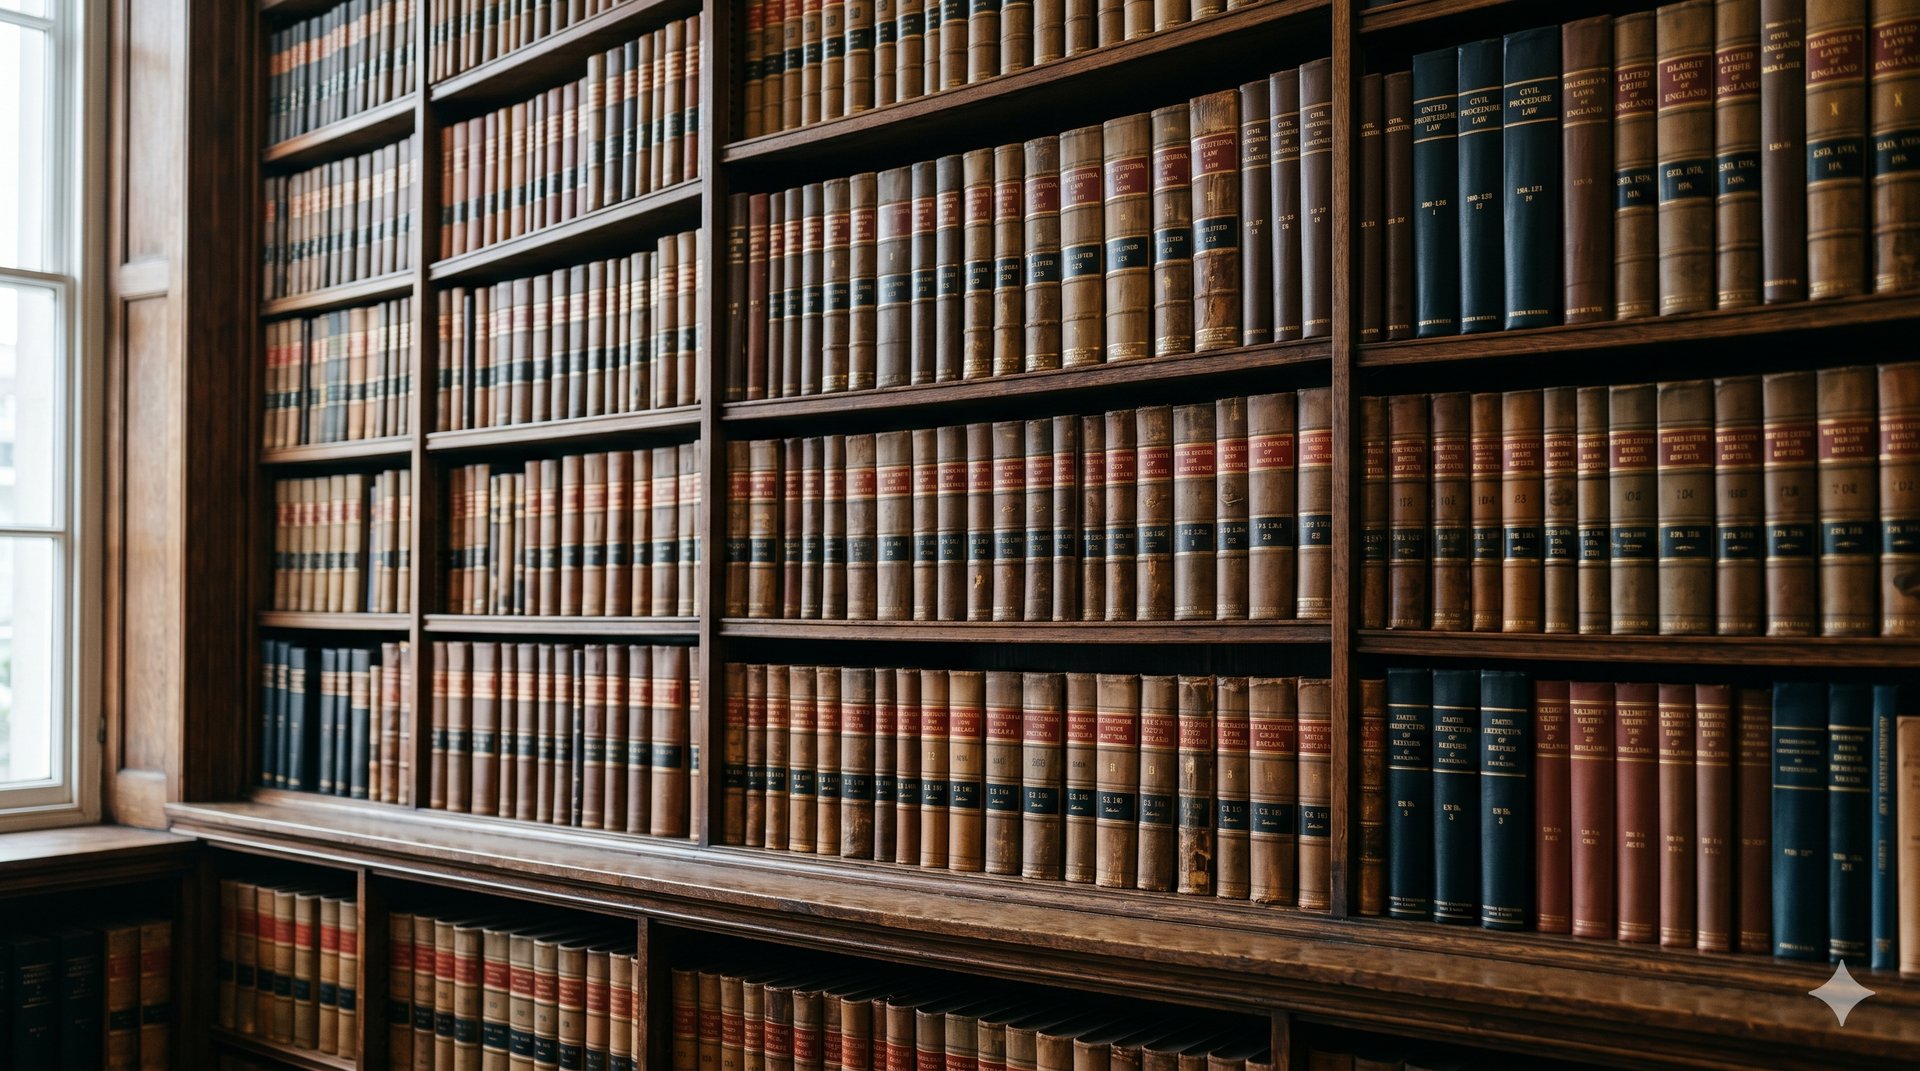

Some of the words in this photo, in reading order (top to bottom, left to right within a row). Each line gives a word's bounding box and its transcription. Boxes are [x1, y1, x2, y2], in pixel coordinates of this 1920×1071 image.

[1672, 70, 1698, 81] LAWS
[1811, 64, 1857, 80] ENGLAND
[1520, 87, 1540, 96] CIVIL
[1573, 88, 1595, 98] LAWS
[1717, 81, 1759, 95] ENGLAND
[1665, 88, 1707, 102] ENGLAND
[1470, 96, 1489, 105] CIVIL
[1509, 94, 1552, 108] PROCEDURE
[1421, 103, 1448, 114] UNITED
[1522, 107, 1538, 116] LAW
[1566, 106, 1603, 118] ENGLAND
[1472, 115, 1488, 125] LAW
[1426, 123, 1441, 132] LAW
[1498, 817, 1504, 825] 3
